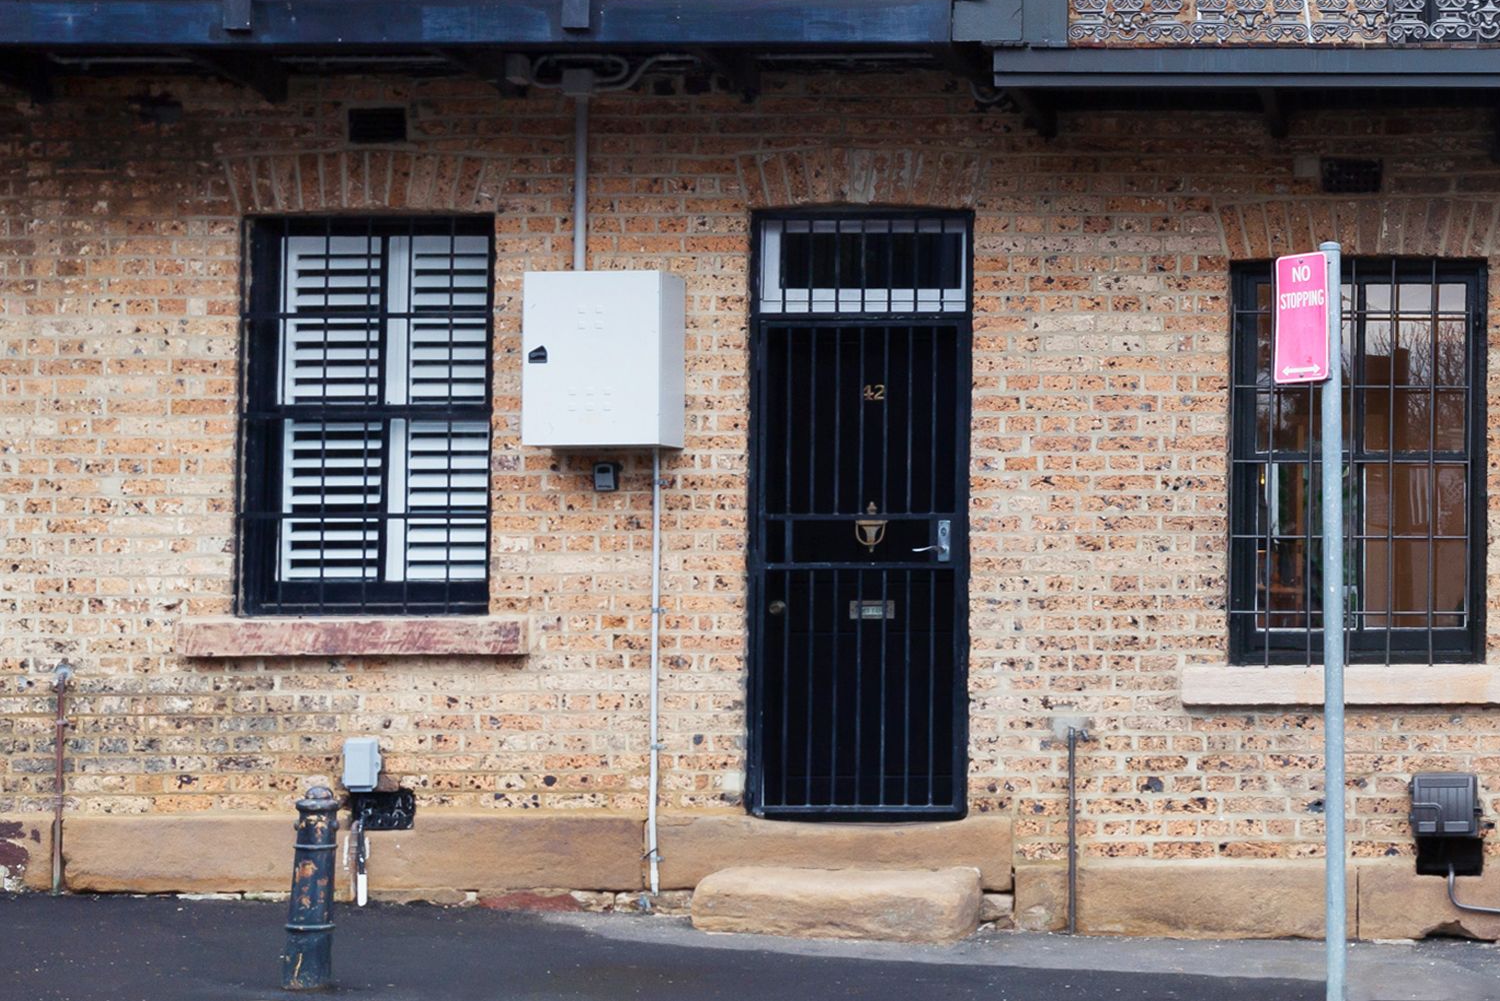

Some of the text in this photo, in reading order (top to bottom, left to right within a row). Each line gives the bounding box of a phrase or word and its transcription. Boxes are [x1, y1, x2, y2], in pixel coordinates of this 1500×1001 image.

[1292, 265, 1311, 282] NO
[1280, 289, 1324, 310] STOPPING
[863, 384, 885, 400] 42
